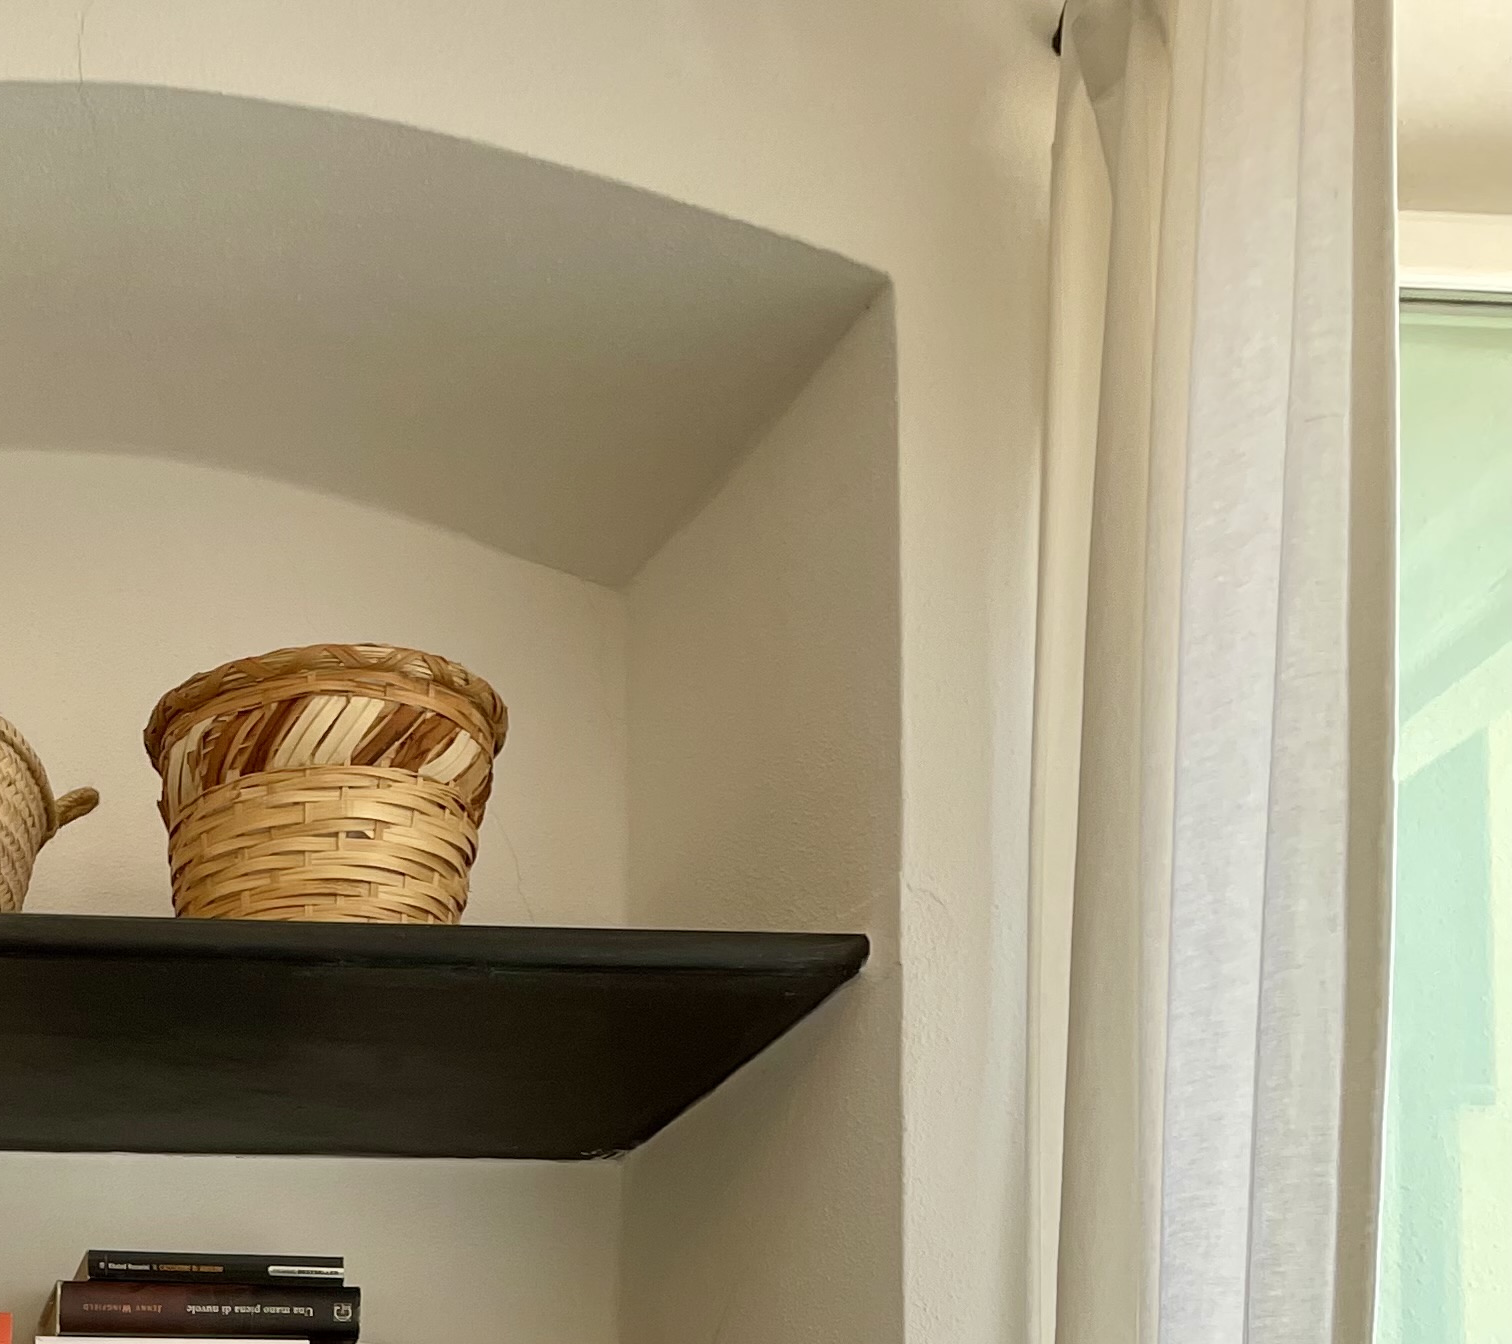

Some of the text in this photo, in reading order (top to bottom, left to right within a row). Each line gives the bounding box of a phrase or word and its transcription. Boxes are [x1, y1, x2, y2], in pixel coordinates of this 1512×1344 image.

[221, 1305, 232, 1315] di
[234, 1305, 261, 1316] piena
[263, 1306, 291, 1314] mano
[293, 1307, 314, 1317] Una
